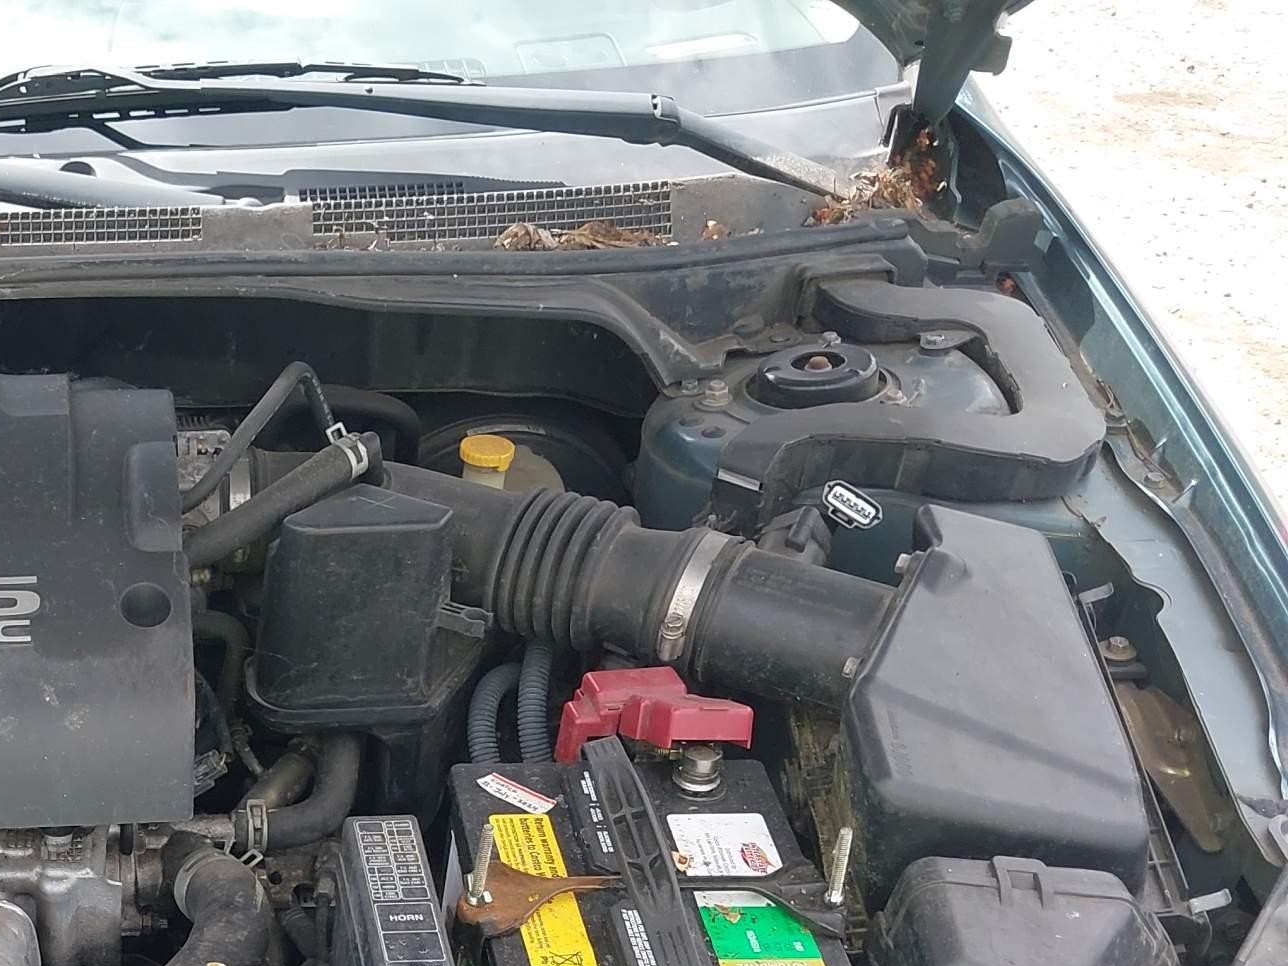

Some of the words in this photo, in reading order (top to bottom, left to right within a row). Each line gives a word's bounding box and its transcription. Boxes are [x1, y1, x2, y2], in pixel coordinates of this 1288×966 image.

[518, 816, 535, 844] batteries
[533, 817, 547, 838] Return
[539, 838, 556, 865] warranty
[389, 913, 424, 922] HORN
